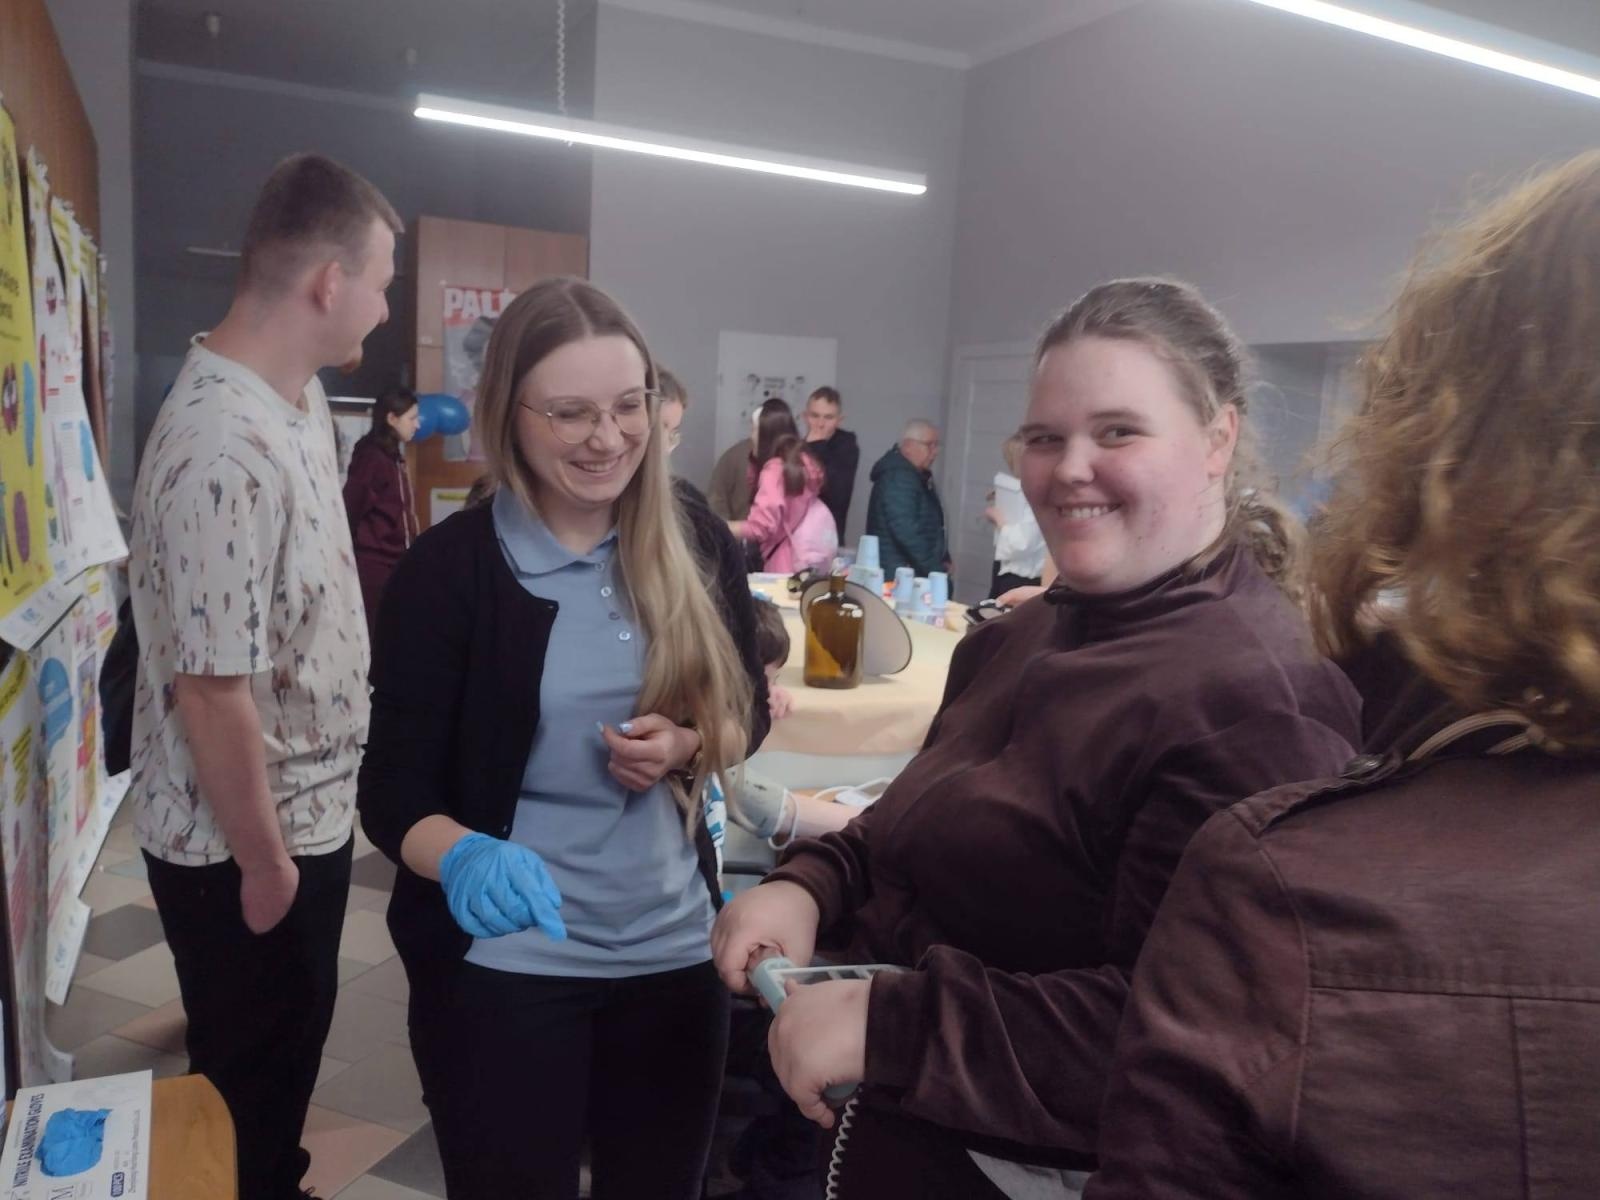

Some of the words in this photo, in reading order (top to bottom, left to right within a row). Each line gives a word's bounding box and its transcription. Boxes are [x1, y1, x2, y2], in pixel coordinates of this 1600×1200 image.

[27, 1093, 45, 1116] GLOVES
[18, 1115, 41, 1161] EXAMINATION
[12, 1160, 32, 1189] NITRILE
